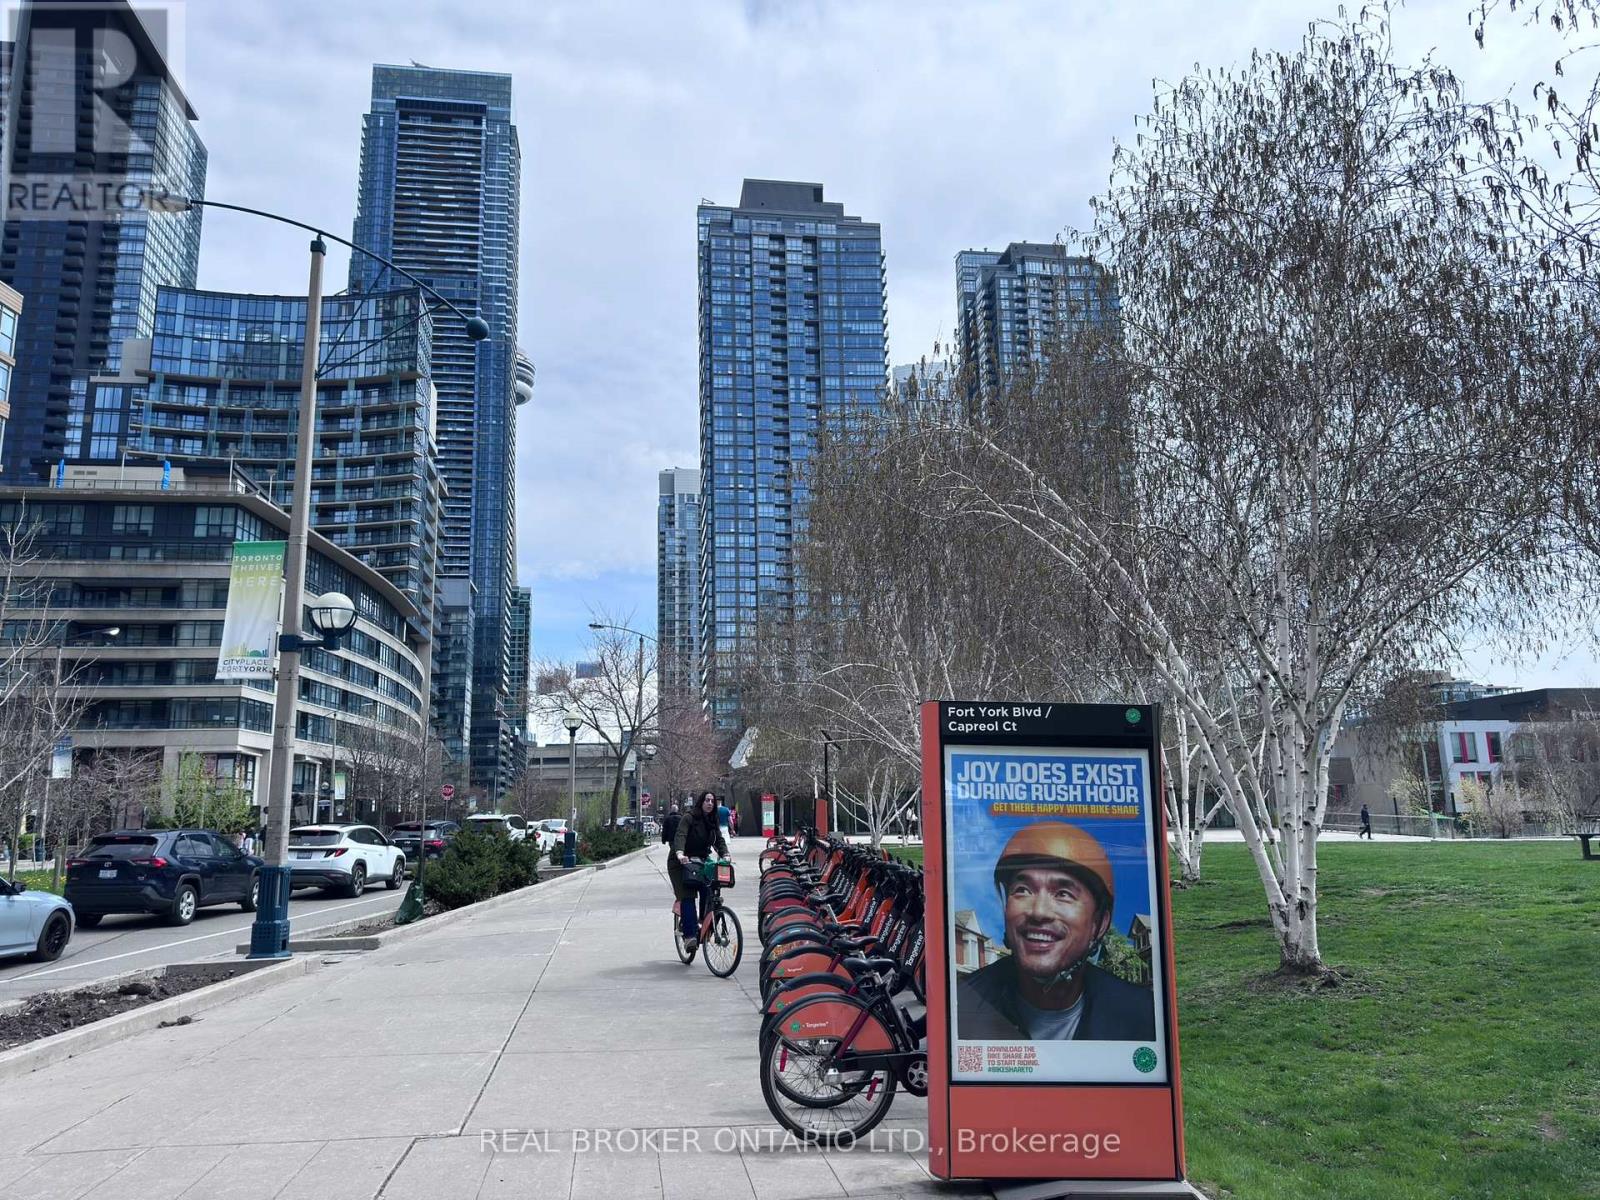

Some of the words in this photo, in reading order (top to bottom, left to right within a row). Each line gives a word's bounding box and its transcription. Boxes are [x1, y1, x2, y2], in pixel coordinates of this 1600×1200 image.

[234, 563, 281, 571] THRIVES
[233, 576, 279, 587] HERE
[948, 706, 975, 717] Fort
[979, 706, 1009, 717] York
[1012, 706, 1042, 717] Blvd
[948, 721, 999, 733] Capreol
[1002, 721, 1018, 731] Ct
[957, 761, 1000, 783] JOY
[1005, 762, 1067, 784] DOES
[1071, 764, 1137, 786] EXIST
[957, 782, 1027, 801] DURING
[1031, 784, 1082, 802] RUSH
[1085, 785, 1139, 803] HOUR
[993, 803, 1008, 812] GET
[1010, 803, 1035, 813] THERE
[1037, 803, 1064, 814] HAPPY
[1066, 804, 1089, 814] WITH
[1090, 805, 1110, 814] BIKE
[1111, 805, 1140, 815] SHARE
[889, 923, 906, 953] Tangerine
[905, 934, 924, 966] Tangerine
